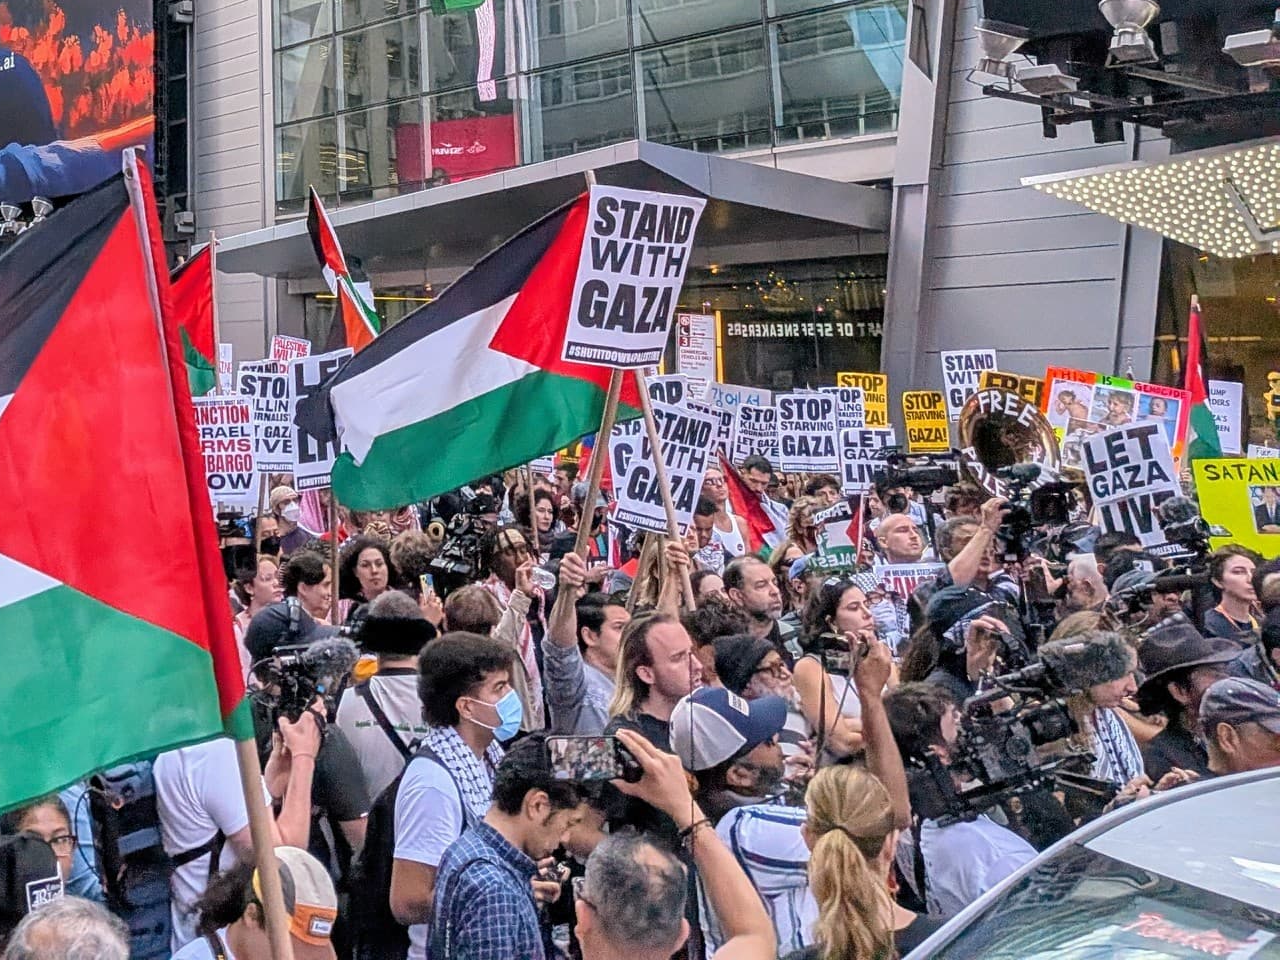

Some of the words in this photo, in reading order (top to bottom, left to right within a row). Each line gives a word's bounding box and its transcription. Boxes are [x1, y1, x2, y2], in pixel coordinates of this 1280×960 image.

[594, 196, 695, 244] STAND
[591, 237, 687, 278] WITH
[577, 279, 673, 334] GAZA
[274, 338, 308, 353] PALESTINE
[945, 354, 994, 371] STAND
[841, 375, 884, 392] STOP
[1052, 369, 1087, 382] THIS
[1102, 376, 1113, 385] IS
[241, 374, 289, 399] STO
[864, 393, 885, 403] VING
[905, 393, 942, 410] STOP
[1212, 399, 1230, 407] DERS
[194, 405, 250, 425] ANCTION
[780, 398, 832, 421] STOP
[906, 410, 945, 421] STARVING
[978, 390, 1037, 427] FREE
[865, 410, 885, 425] ZA!
[1213, 414, 1228, 422] ZA'S
[198, 427, 250, 439] RAEL
[654, 409, 712, 449] STAND
[780, 421, 834, 432] STARVING
[737, 435, 754, 446] LET
[843, 430, 891, 447] LET
[909, 428, 948, 443] GAZA!
[202, 439, 251, 453] RMS
[255, 439, 292, 453] IVE
[782, 435, 836, 457] GAZA
[844, 448, 886, 460] GAZ
[1083, 424, 1159, 475] LET
[205, 454, 253, 473] BARGO
[642, 437, 706, 473] WITH
[846, 463, 888, 483] LIV
[1092, 460, 1171, 498] GAZA
[1204, 462, 1279, 482] SATAN
[207, 474, 253, 489] OW
[627, 466, 697, 513] GAZA
